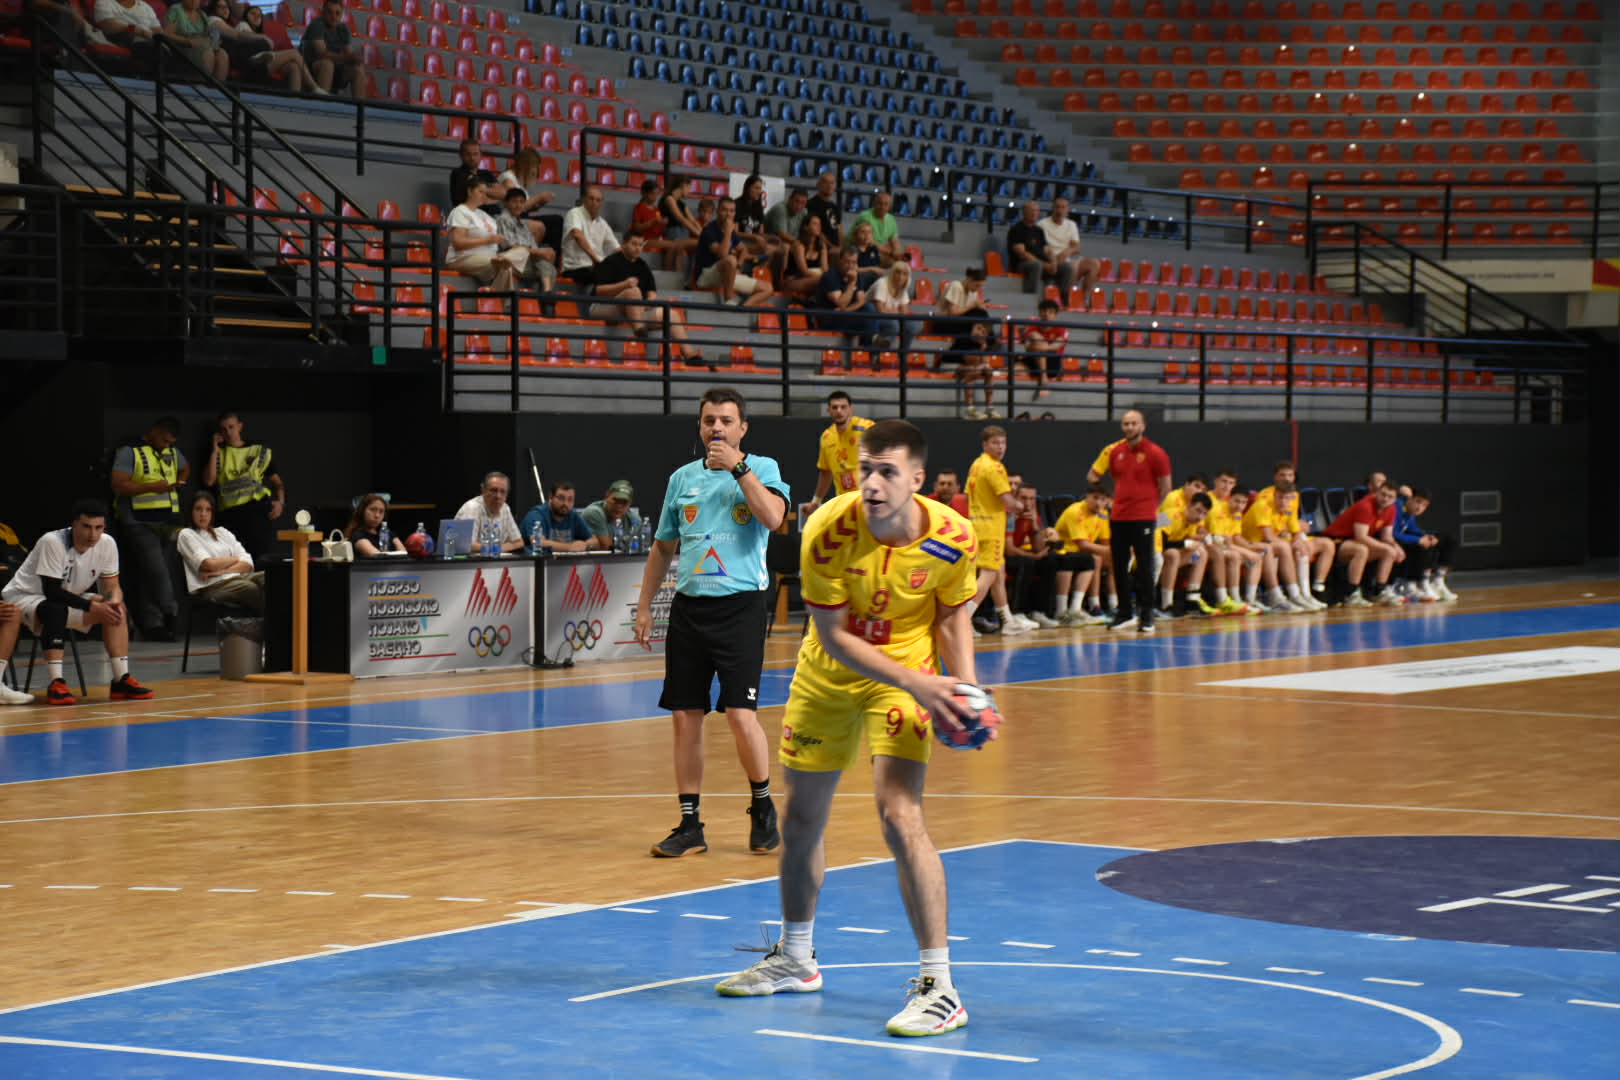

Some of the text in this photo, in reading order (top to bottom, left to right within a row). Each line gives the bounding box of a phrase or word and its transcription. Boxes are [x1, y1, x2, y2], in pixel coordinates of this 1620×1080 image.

[869, 588, 890, 616] 9
[369, 641, 422, 659] ЗАЕДНО
[886, 707, 904, 737] 9
